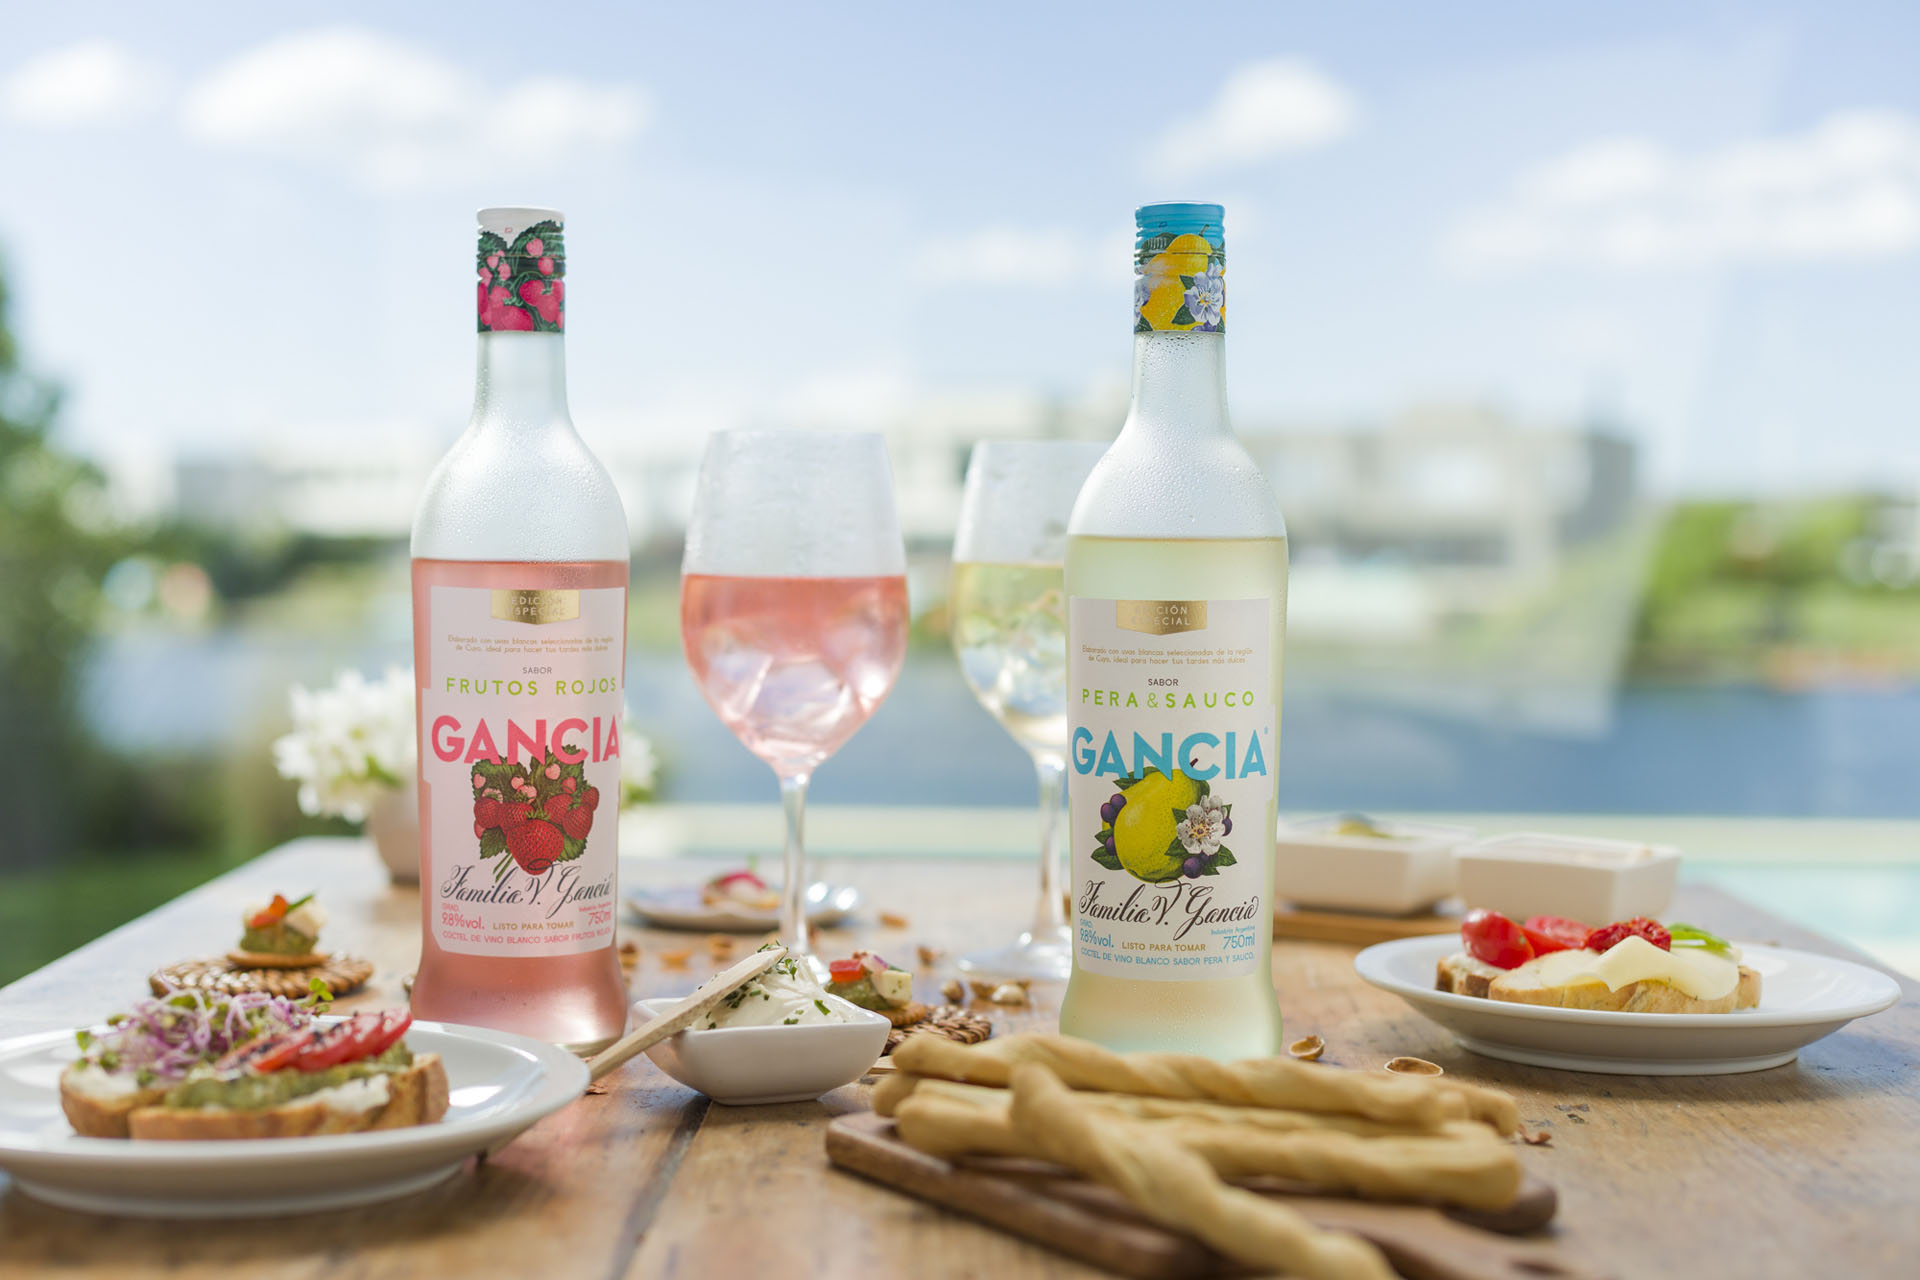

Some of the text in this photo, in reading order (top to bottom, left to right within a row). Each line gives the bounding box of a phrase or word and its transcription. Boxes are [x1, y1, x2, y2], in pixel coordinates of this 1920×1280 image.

[1135, 604, 1188, 616] CIÓN
[1131, 616, 1191, 627] ECIAL
[1138, 647, 1164, 656] blancas
[1216, 648, 1225, 656] de
[1130, 657, 1147, 666] para
[1149, 656, 1169, 665] hacer
[522, 666, 553, 675] SABOR
[446, 677, 616, 696] FRUTOS ROJOS
[1147, 678, 1179, 687] SABOR
[431, 714, 620, 766] GANCIA
[440, 864, 524, 905] Familia
[545, 865, 613, 919] Gancia
[1079, 878, 1259, 941] Familia V. Gancia
[493, 920, 574, 931] LISTO PARA TOMAR
[470, 934, 481, 943] DE
[484, 935, 504, 944] VINO
[507, 936, 541, 945] BLANCO
[544, 934, 570, 944] SABOR
[1223, 933, 1256, 950] 750ml
[1122, 941, 1206, 952] LISTO PARA TOMAR
[1103, 952, 1112, 961] DE
[1114, 954, 1133, 964] VINO
[1136, 956, 1170, 966] BLANCO
[1173, 956, 1200, 966] SABOR
[1203, 955, 1223, 965] PERA
